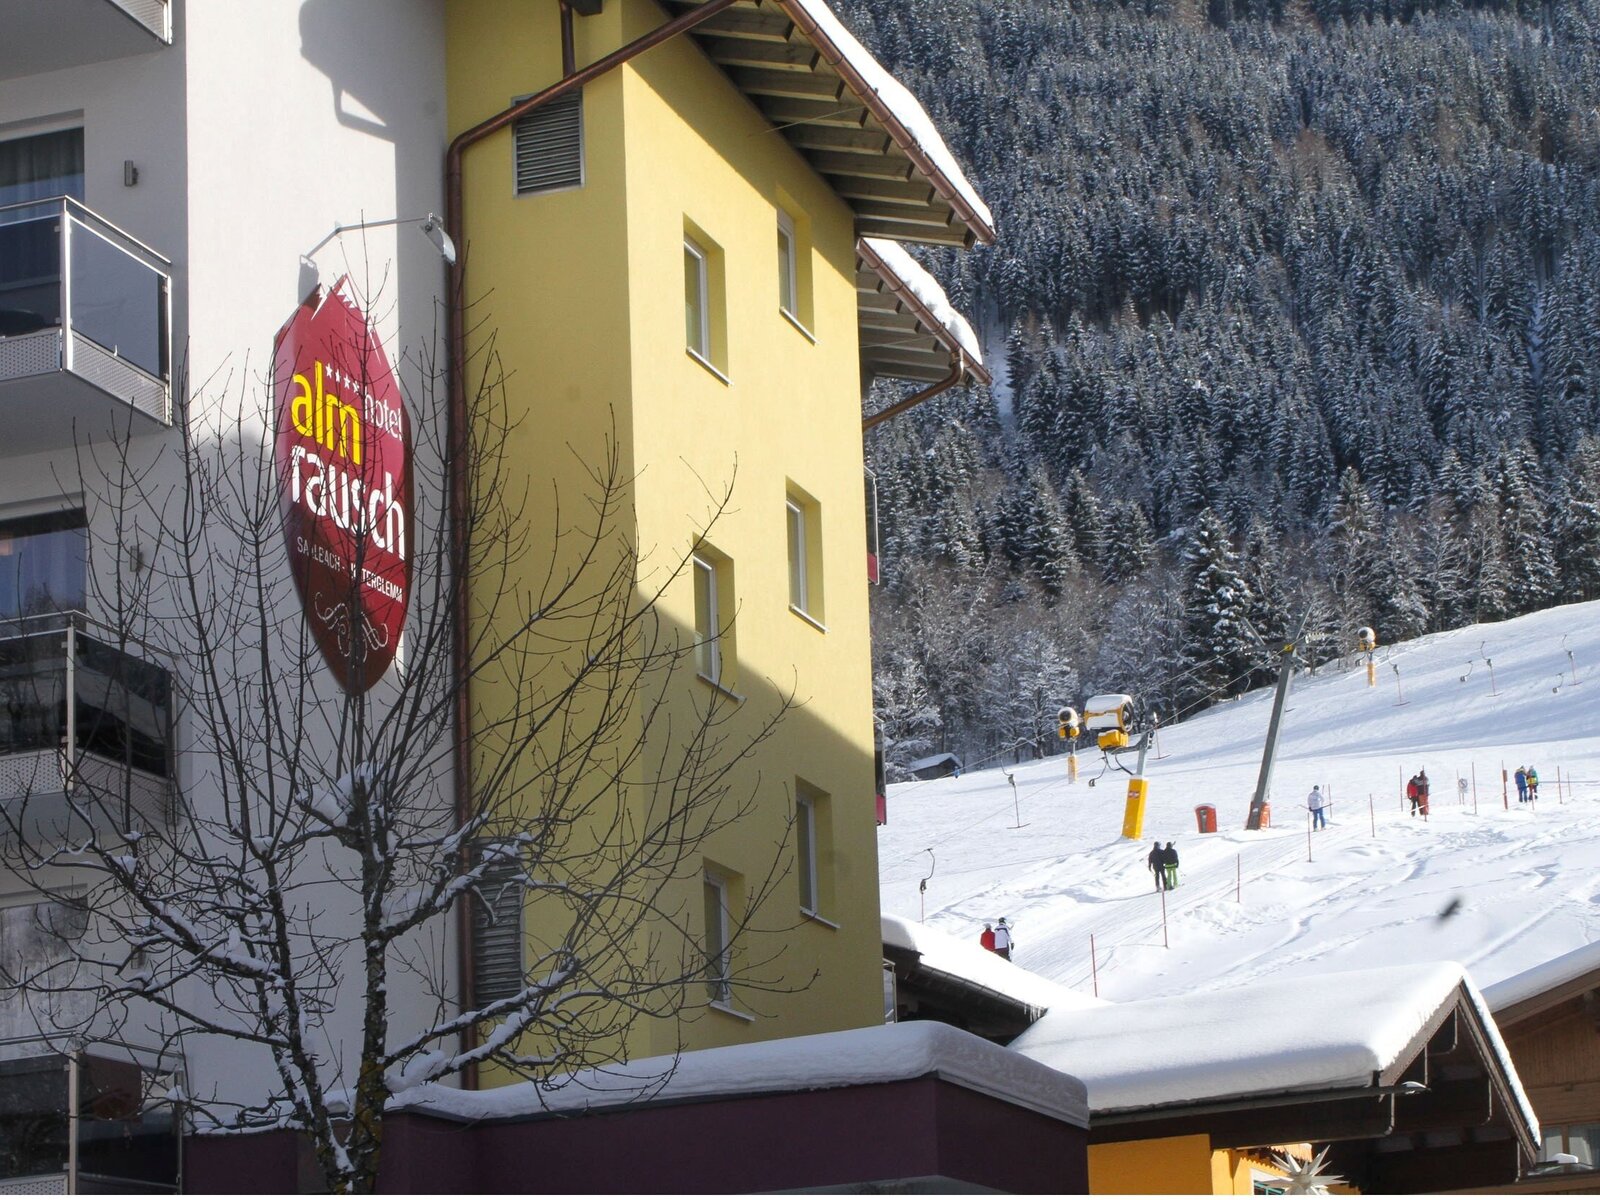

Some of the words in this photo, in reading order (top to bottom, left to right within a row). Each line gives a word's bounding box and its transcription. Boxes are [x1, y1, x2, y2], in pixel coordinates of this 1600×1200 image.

[291, 360, 361, 465] alm
[364, 385, 402, 441] hotel
[290, 445, 405, 561] rausch
